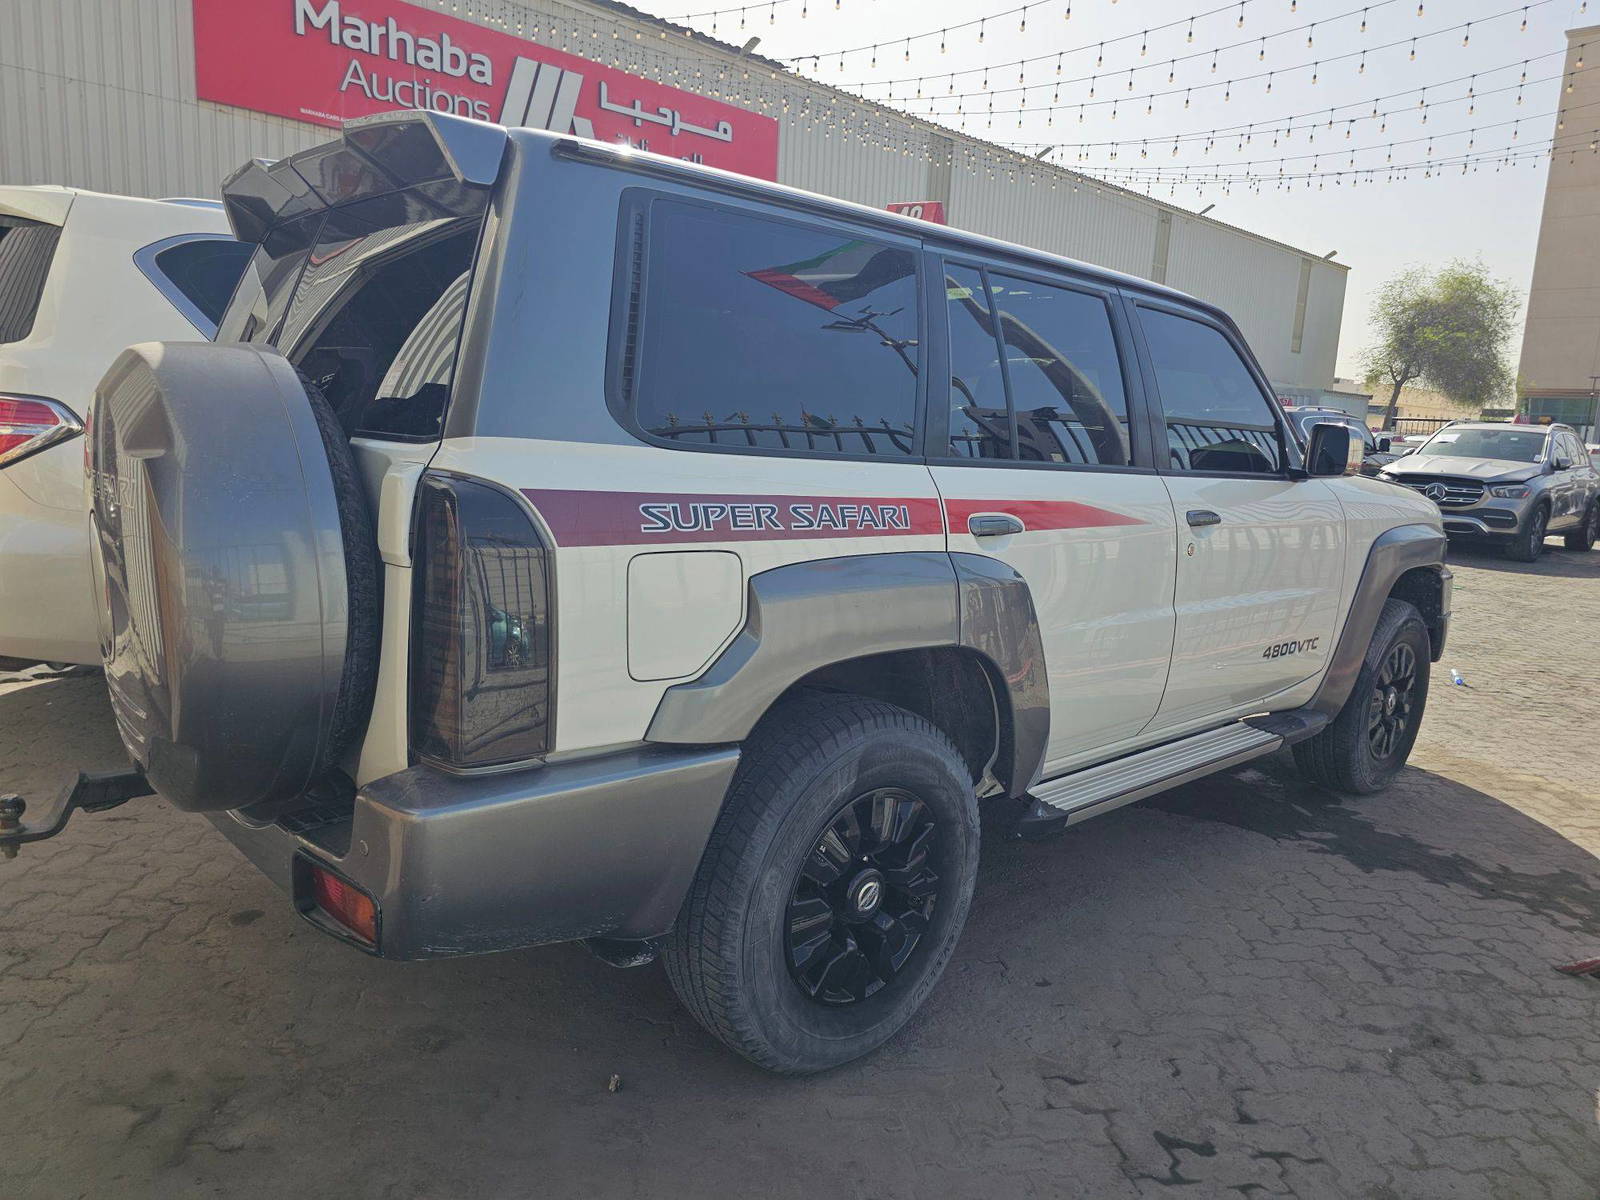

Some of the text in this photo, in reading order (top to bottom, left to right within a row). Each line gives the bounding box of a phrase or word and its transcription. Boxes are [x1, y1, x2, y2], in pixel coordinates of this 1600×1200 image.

[294, 0, 493, 86] Marhaba
[339, 59, 491, 121] Auctions
[639, 503, 911, 533] SUPER SAFARI
[1262, 636, 1319, 660] 4800VTC
